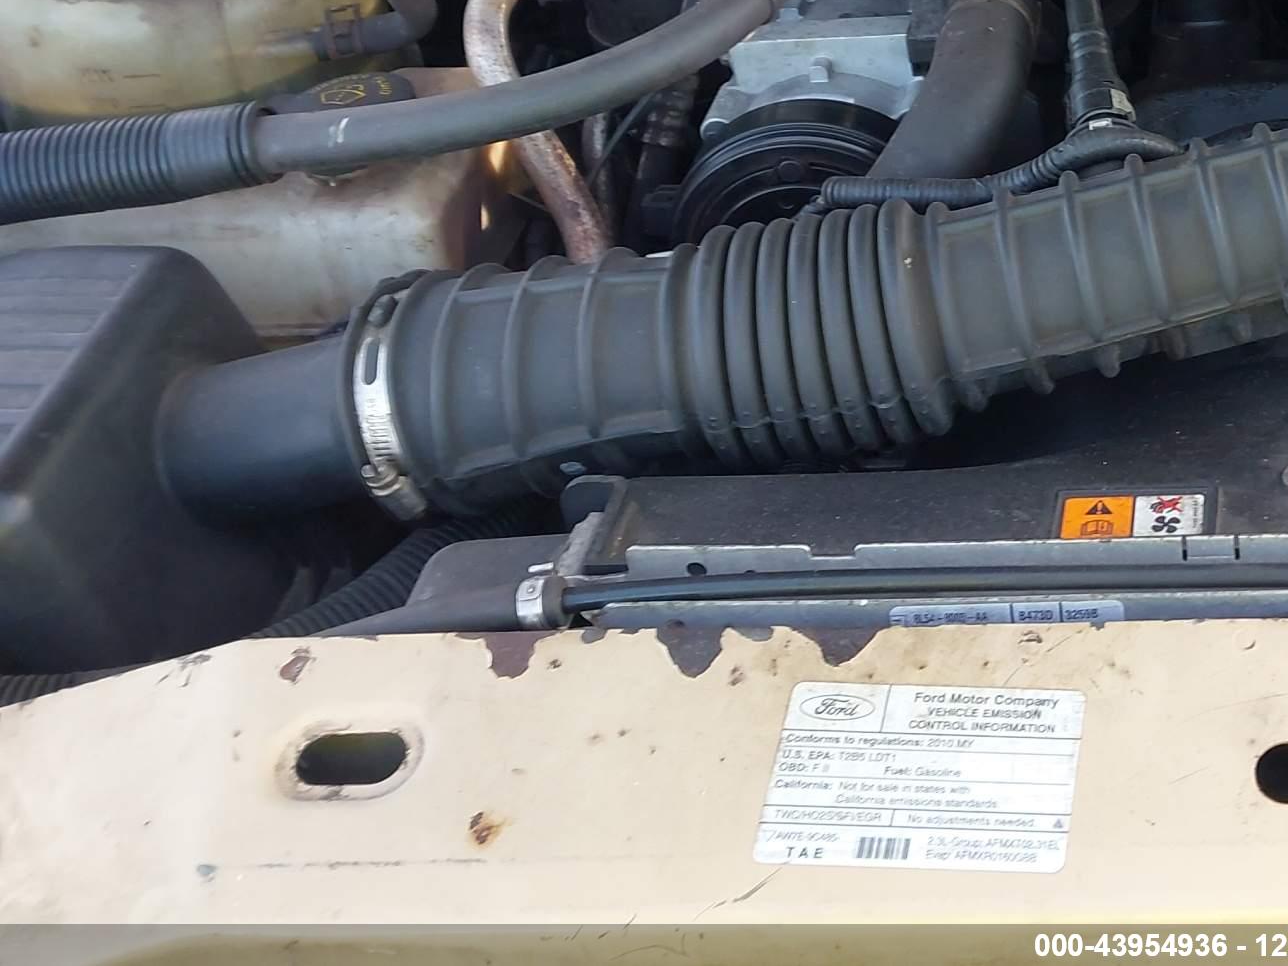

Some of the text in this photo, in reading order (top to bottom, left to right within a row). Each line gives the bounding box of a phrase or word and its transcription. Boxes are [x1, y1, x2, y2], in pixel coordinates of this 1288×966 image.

[914, 692, 1059, 709] Ford Motor Company
[814, 697, 860, 716] Ford
[928, 707, 1042, 719] VEHICLE EMISSION
[908, 719, 1056, 733] CONTROL INFORMATION
[785, 734, 840, 744] Conforms
[844, 735, 855, 744] to
[915, 766, 961, 777] Gasoline
[839, 781, 857, 791] Not
[834, 794, 886, 805] California
